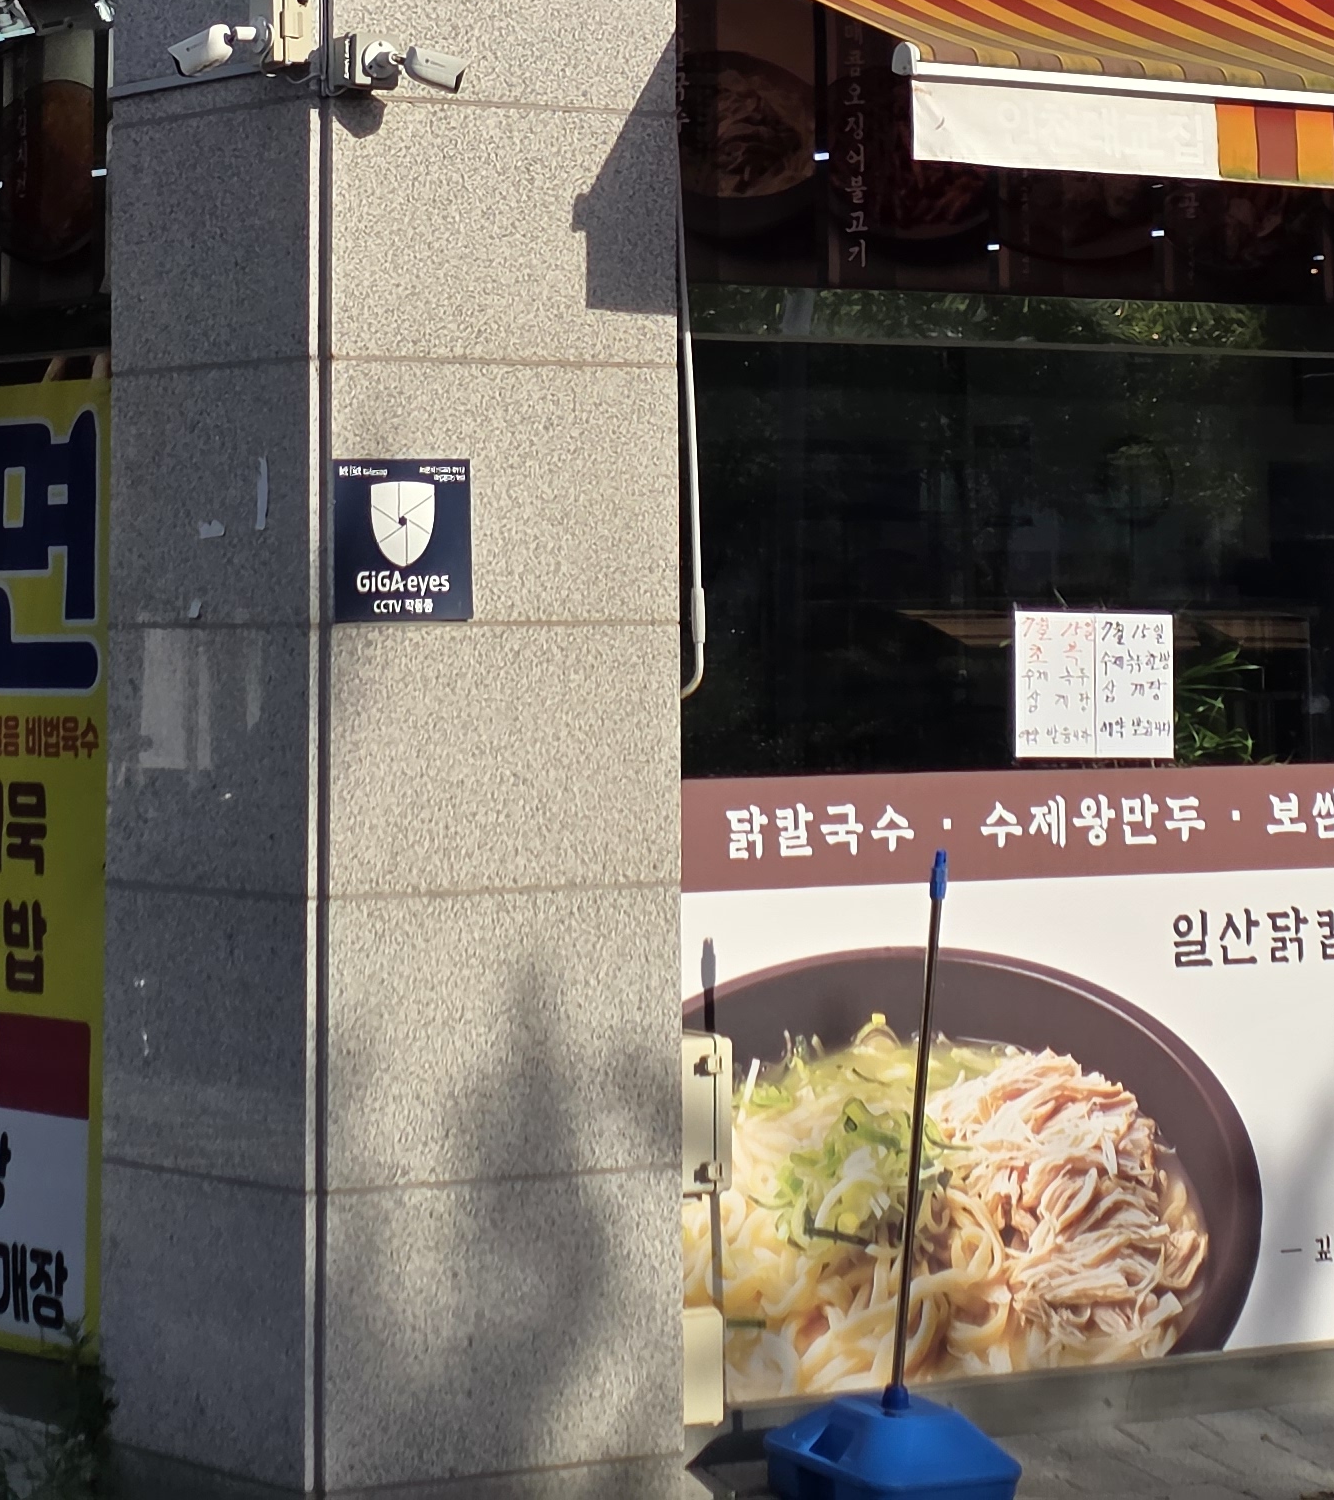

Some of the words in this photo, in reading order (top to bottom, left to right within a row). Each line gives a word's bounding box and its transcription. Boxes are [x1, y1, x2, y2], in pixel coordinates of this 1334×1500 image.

[373, 599, 402, 614] CCTV
[25, 715, 99, 759] 비법육수
[724, 801, 917, 863] 닭칼국수
[979, 791, 1207, 851] 수제왕만두
